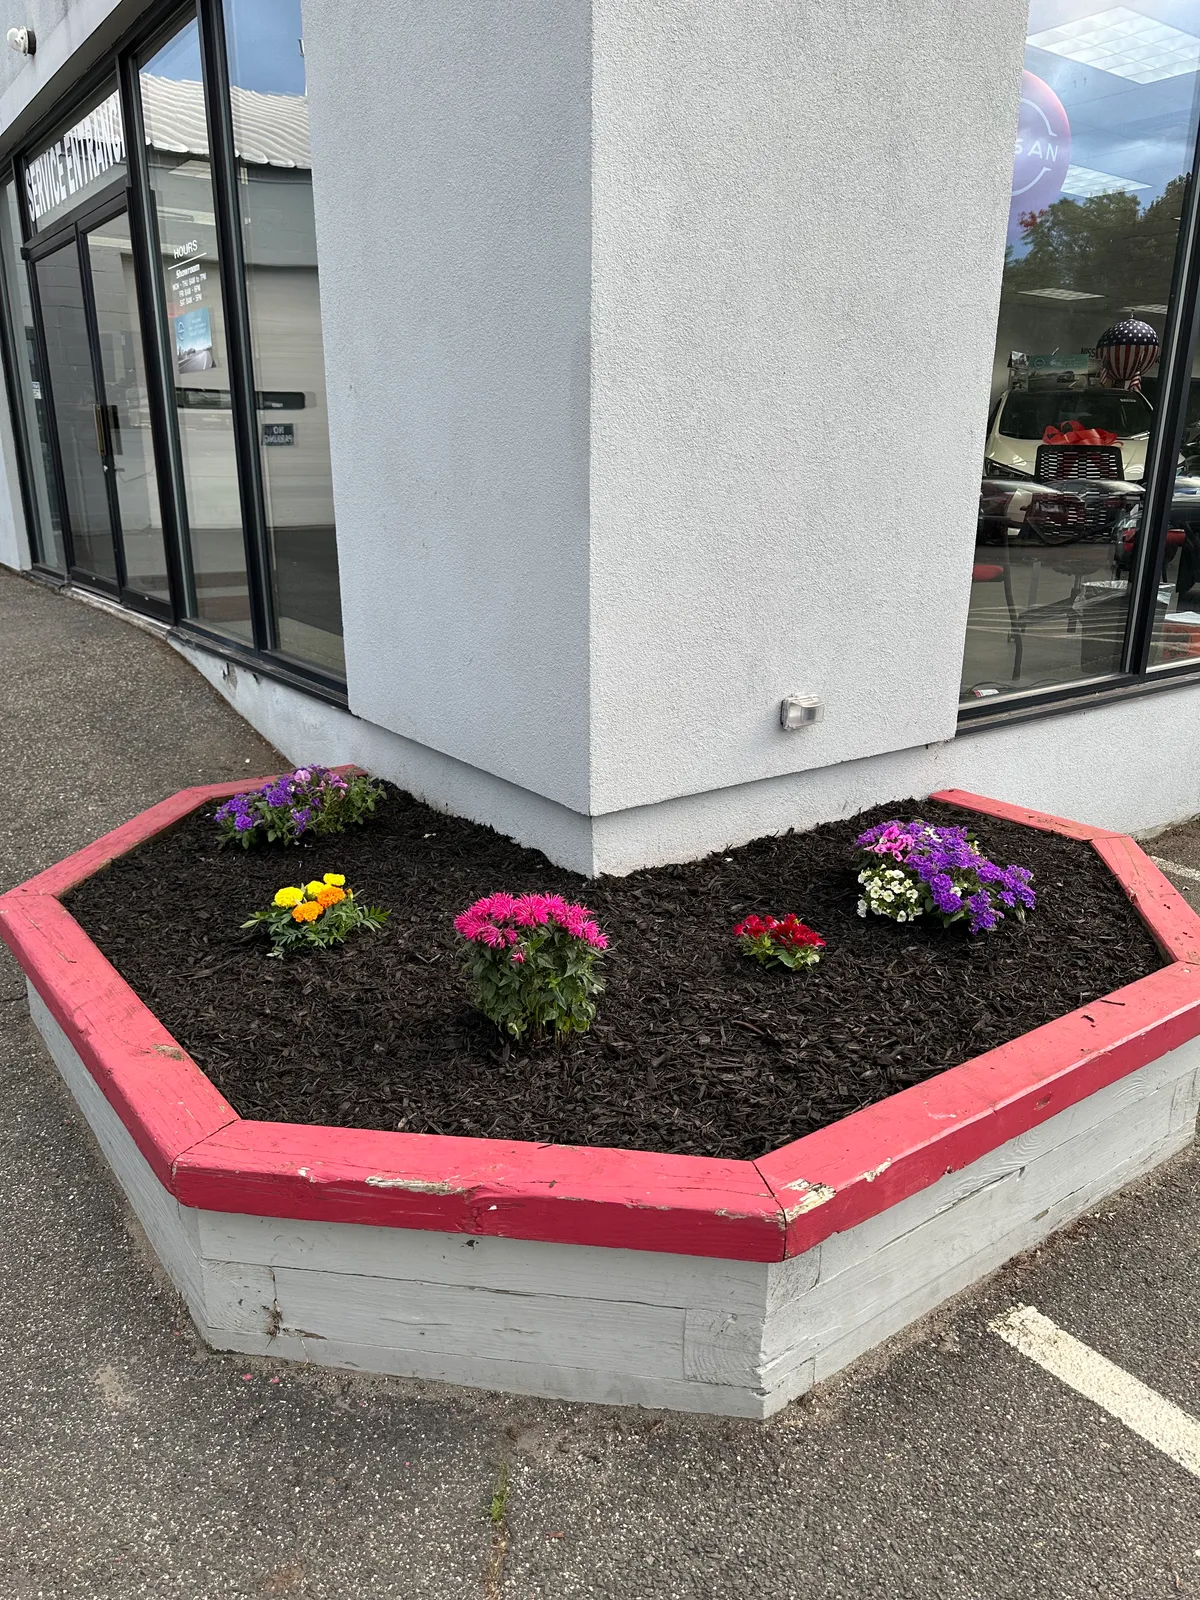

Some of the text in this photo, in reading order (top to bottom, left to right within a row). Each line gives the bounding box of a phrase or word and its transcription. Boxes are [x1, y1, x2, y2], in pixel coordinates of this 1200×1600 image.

[1014, 138, 1059, 162] SAN
[25, 140, 67, 222] SERVICE
[173, 239, 198, 259] HOURS
[175, 263, 200, 279] Showroom
